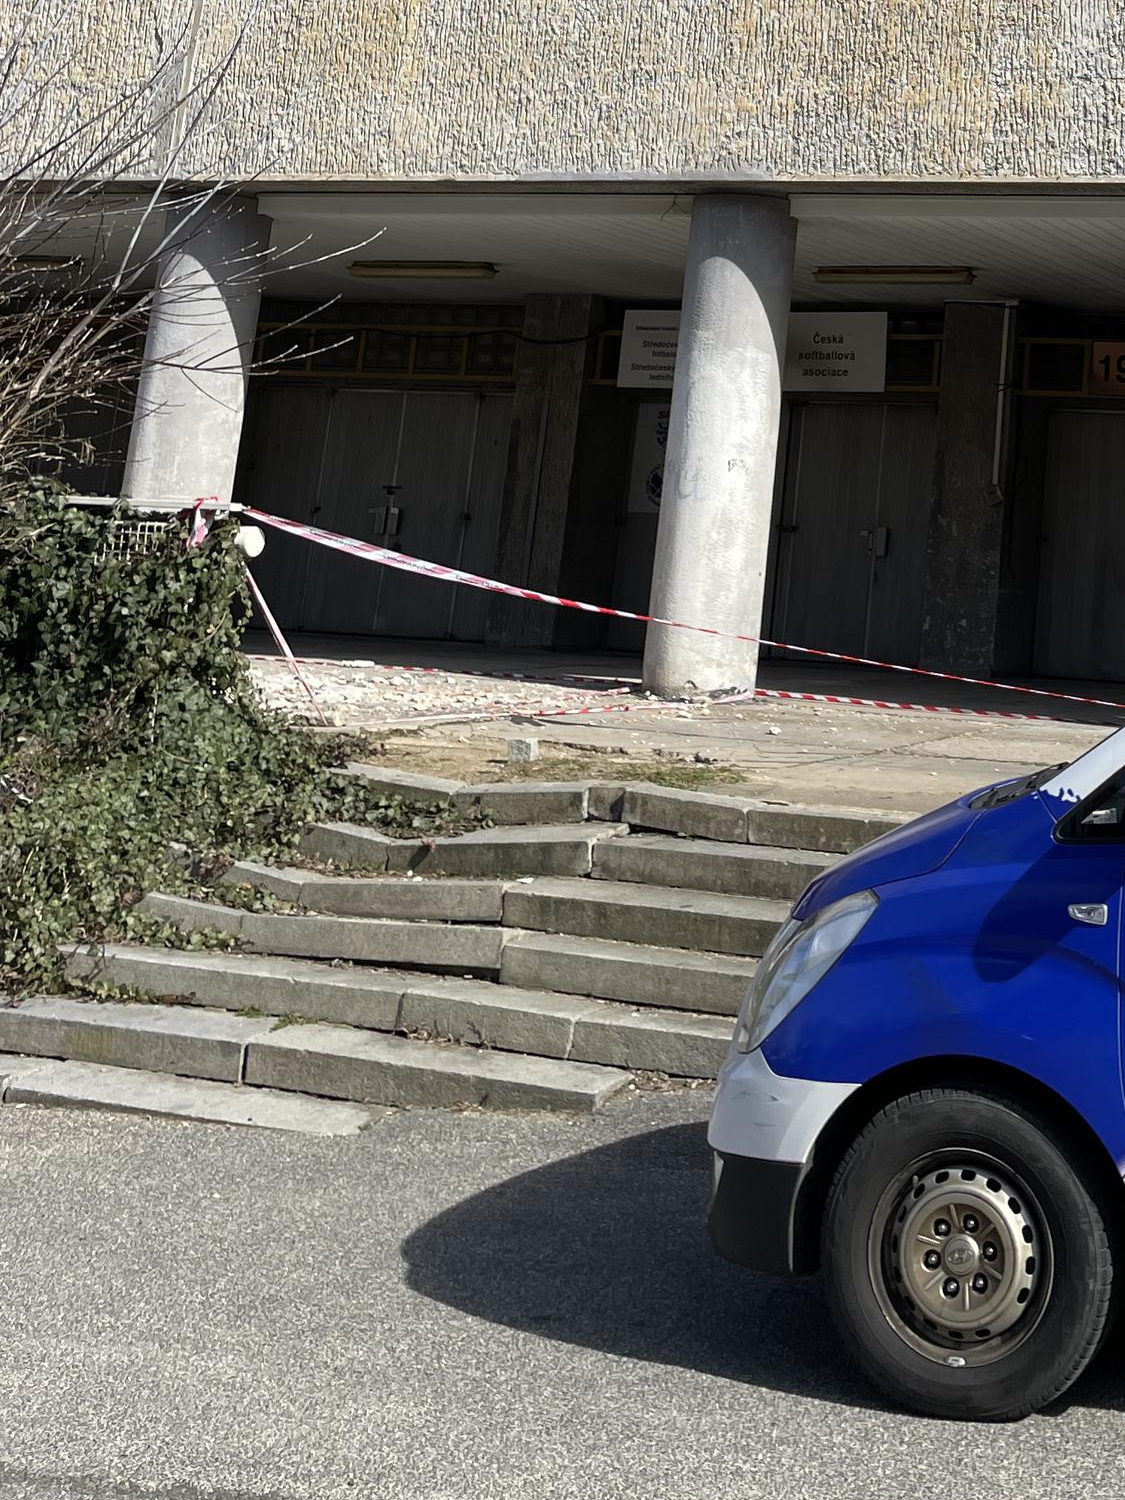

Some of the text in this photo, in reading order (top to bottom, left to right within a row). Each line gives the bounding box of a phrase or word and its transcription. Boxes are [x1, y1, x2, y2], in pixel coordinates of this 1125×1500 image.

[812, 331, 844, 345] Česká
[798, 349, 856, 361] softballová
[801, 366, 849, 377] asociace
